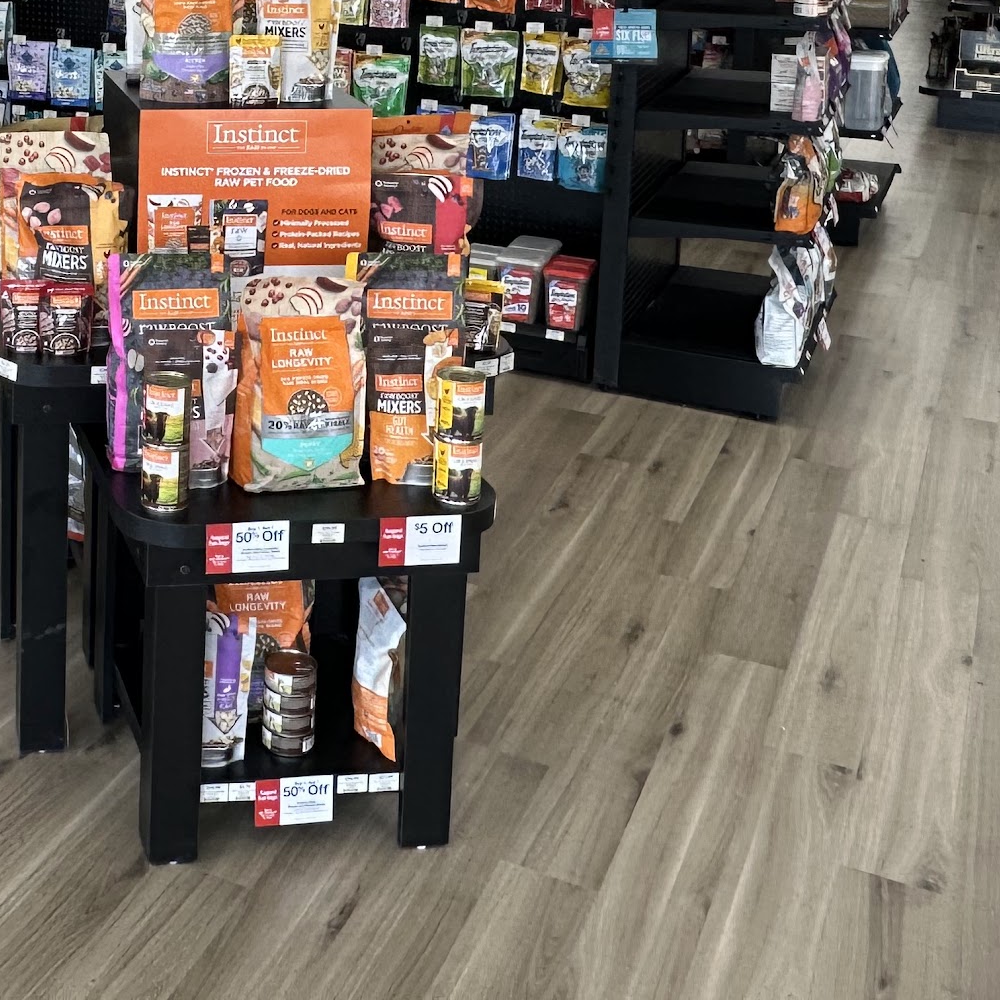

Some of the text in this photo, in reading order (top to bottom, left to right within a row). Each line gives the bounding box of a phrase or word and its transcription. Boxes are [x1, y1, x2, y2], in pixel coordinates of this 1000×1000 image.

[266, 5, 305, 15] Instinct
[264, 26, 306, 38] MIXERS
[213, 123, 301, 144] Instinct
[216, 167, 261, 176] FROZEN
[263, 167, 271, 176] &
[273, 166, 351, 176] FREEZE-DRIED
[214, 177, 298, 188] RAW PET FOOD
[380, 221, 428, 238] Instinct
[43, 252, 89, 270] MIXERS
[139, 292, 211, 311] Instinct
[373, 292, 446, 311] Instinct
[270, 328, 328, 343] Instinct
[289, 348, 314, 358] RAW
[272, 357, 333, 369] LONGEVITY
[378, 375, 418, 387] Instinct
[377, 399, 422, 414] MIXERS
[414, 521, 454, 534] $5 Off
[236, 530, 286, 543] 50% Off
[246, 592, 270, 601] RAW
[229, 601, 287, 612] LONGEVITY
[283, 784, 330, 797] 50% Off
